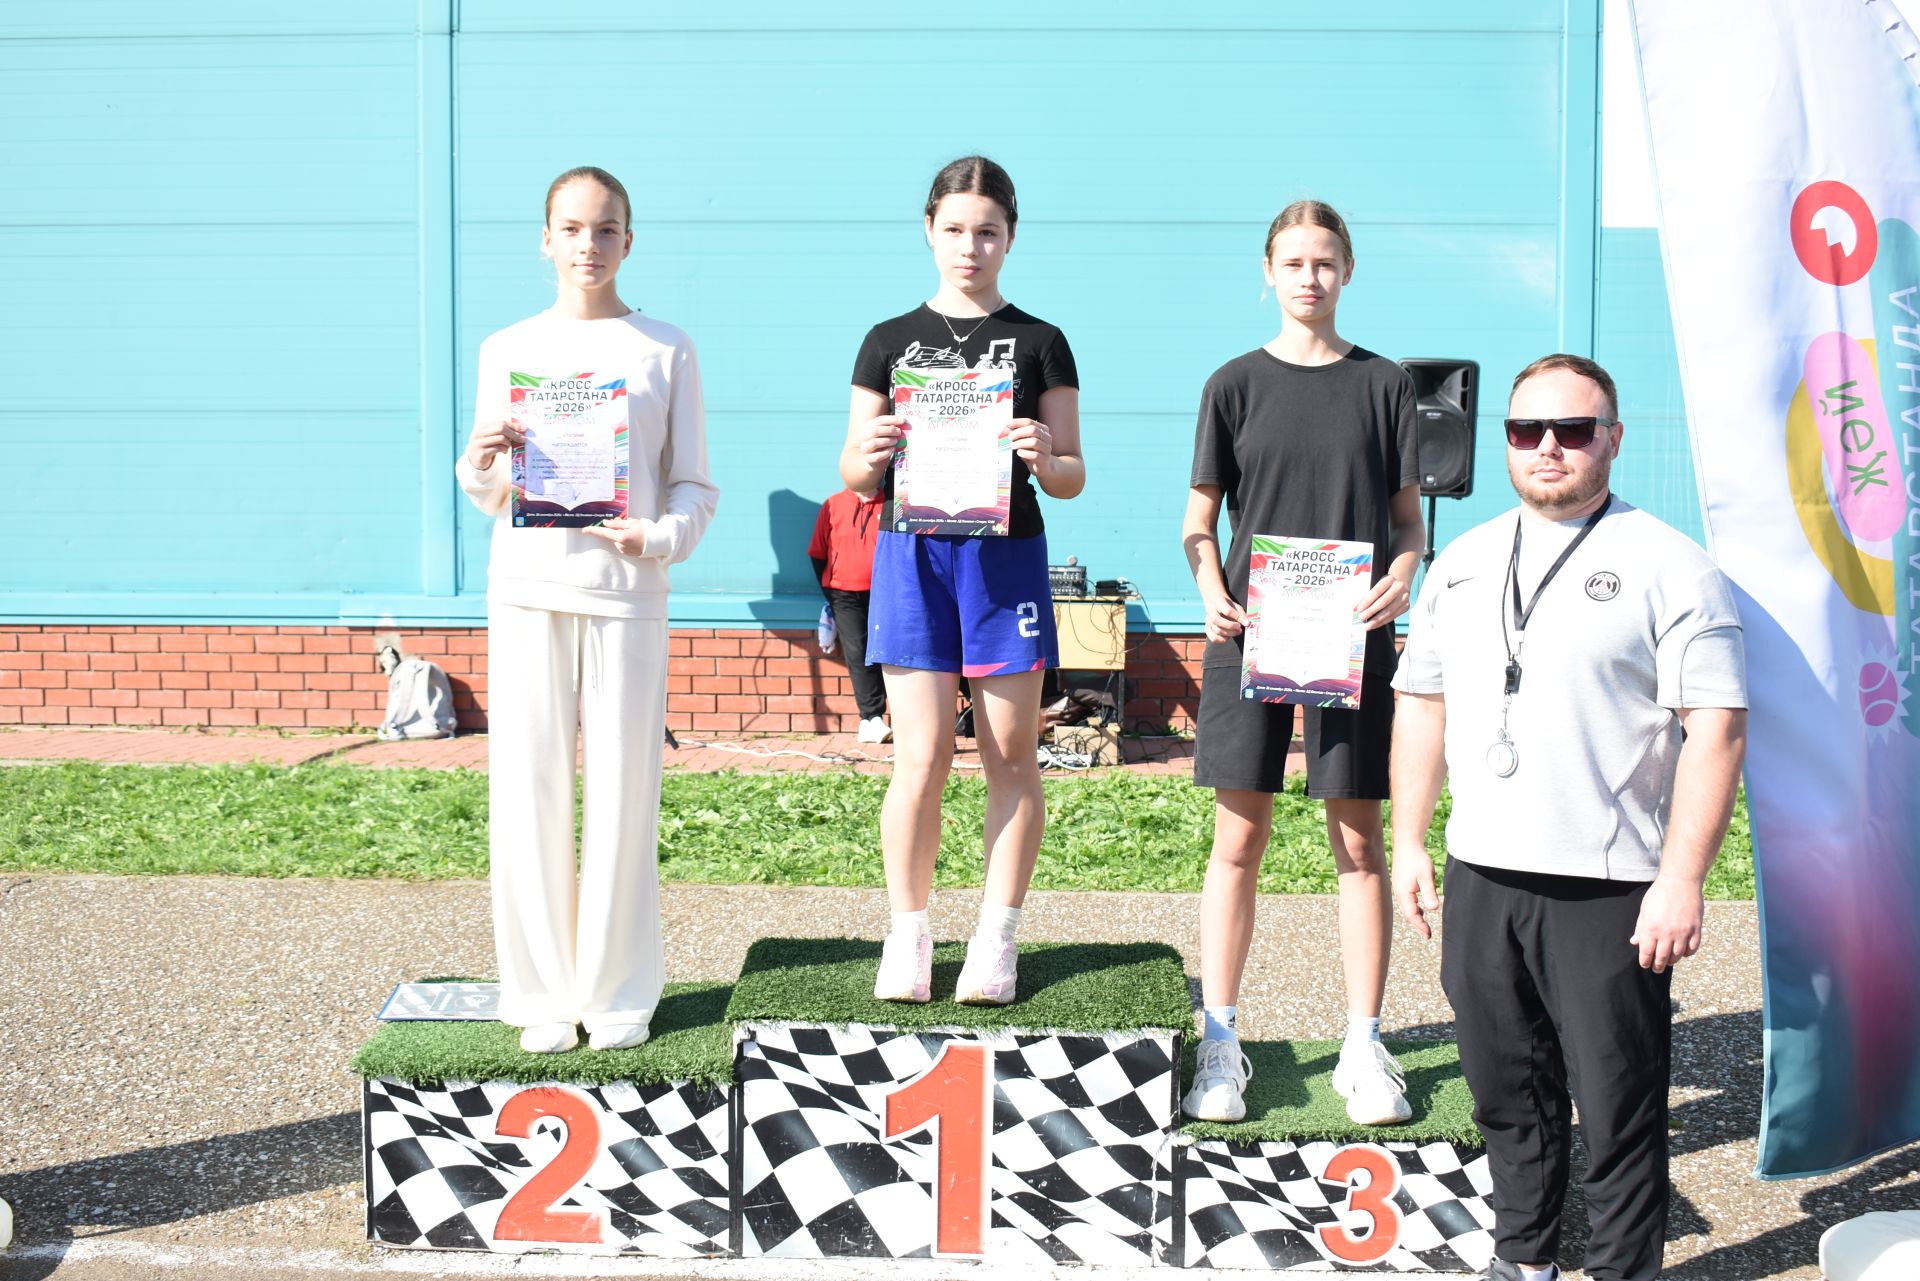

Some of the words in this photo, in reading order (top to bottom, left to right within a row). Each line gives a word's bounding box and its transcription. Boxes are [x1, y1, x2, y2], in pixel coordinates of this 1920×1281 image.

[544, 380, 592, 390] «КРОСС
[928, 381, 977, 392] «КРОСС
[530, 391, 608, 401] ТАТАРСТАНА
[915, 393, 993, 404] ТАТАРСТАНА
[555, 402, 592, 413] 2026»
[939, 405, 976, 416] 2026»
[1286, 550, 1336, 563] «КРОСС
[1271, 560, 1351, 575] ТАТАРСТАНА
[1294, 574, 1333, 586] 2026»
[1016, 601, 1041, 638] 2
[886, 1046, 984, 1253] 1
[495, 1088, 600, 1242] 2
[1320, 1149, 1397, 1261] 3
